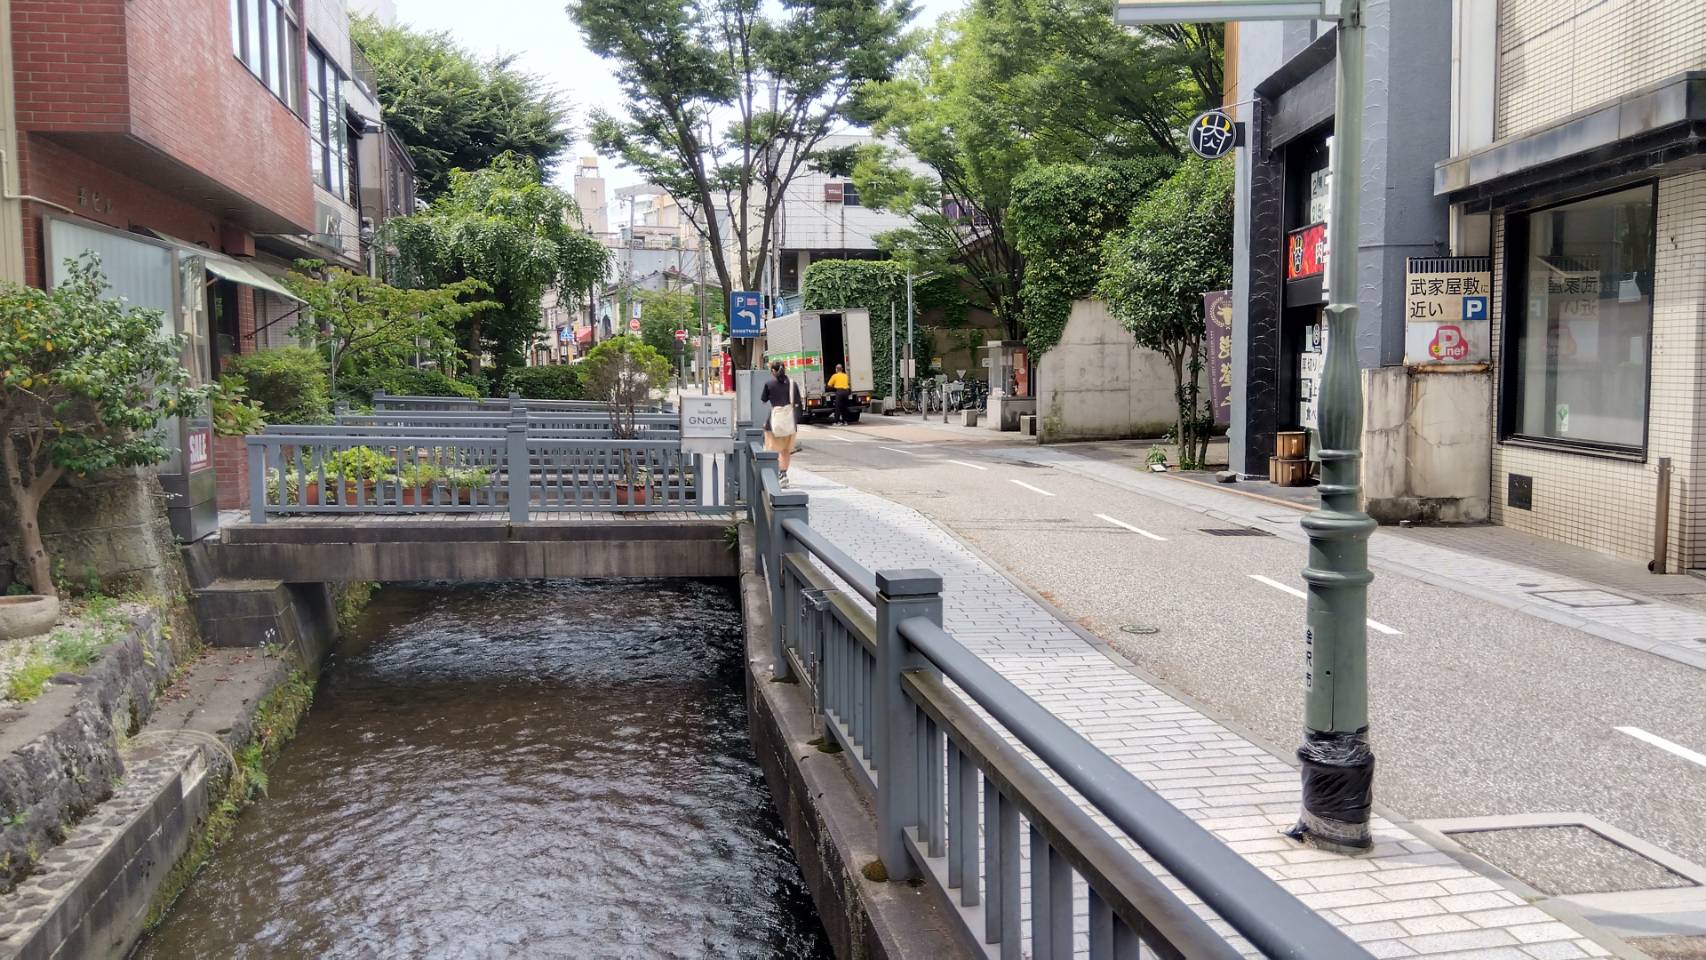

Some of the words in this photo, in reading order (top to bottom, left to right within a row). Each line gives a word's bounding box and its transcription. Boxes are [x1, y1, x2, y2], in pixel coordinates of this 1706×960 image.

[1410, 277, 1488, 296] 武家屋敷に
[736, 296, 744, 307] P
[1410, 300, 1443, 319] 近い
[1466, 300, 1482, 318] P
[688, 416, 728, 425] GNOME
[189, 433, 208, 464] SALE
